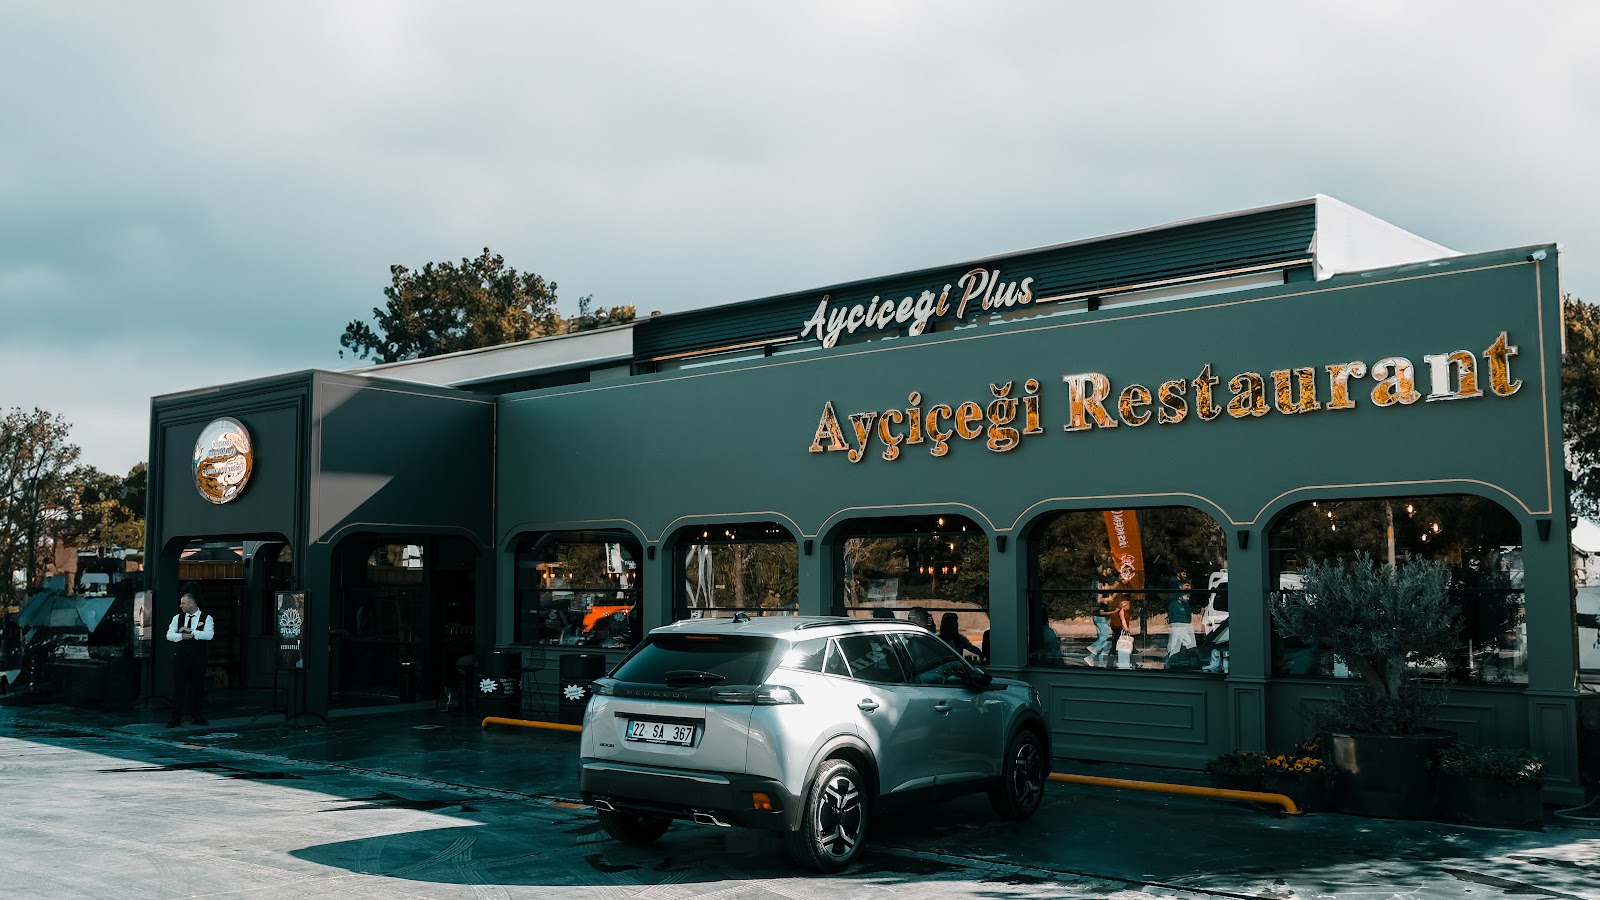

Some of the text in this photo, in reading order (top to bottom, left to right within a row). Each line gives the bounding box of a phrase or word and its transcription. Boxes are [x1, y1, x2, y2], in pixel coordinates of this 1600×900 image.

[957, 268, 1034, 319] Plus
[808, 331, 1523, 463] Ayçiçeği Restaurant
[627, 690, 688, 698] PEUGEOT
[633, 723, 692, 741] 22 SA 367
